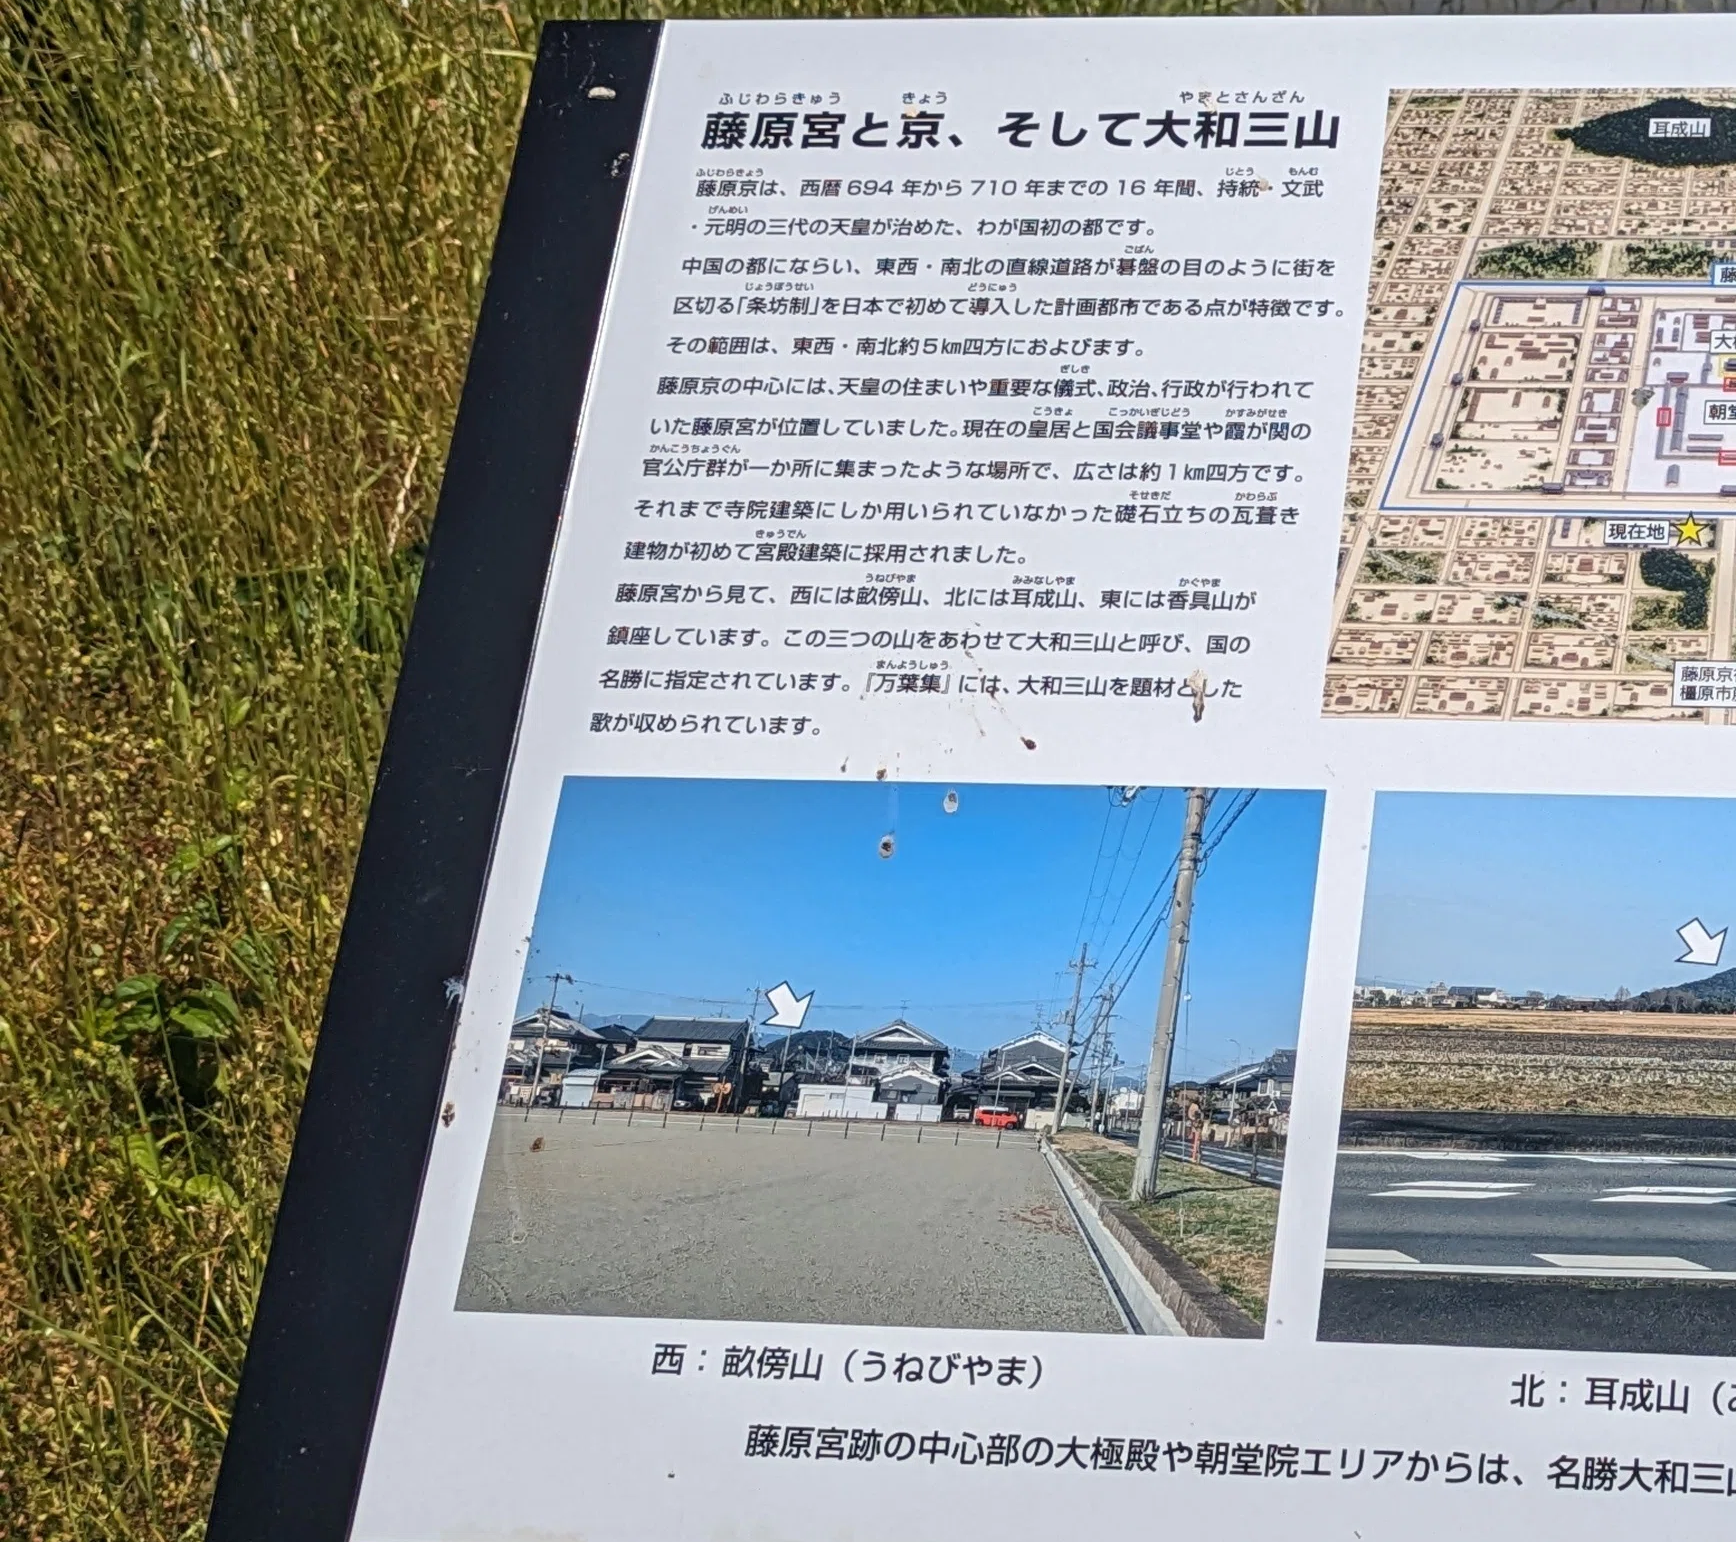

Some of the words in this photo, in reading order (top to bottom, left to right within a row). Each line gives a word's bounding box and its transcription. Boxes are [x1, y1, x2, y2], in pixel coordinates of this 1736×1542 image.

[719, 92, 840, 105] ふじわらきゅう
[903, 92, 947, 104] きょう
[701, 110, 1339, 149] 藤原宮と京、そして大和三山
[1652, 119, 1708, 138] 耳成山
[696, 168, 763, 177] ふじわらきょう
[1226, 167, 1254, 176] じとう
[1289, 167, 1318, 175] もんむ
[709, 206, 748, 214] げんめい
[1125, 245, 1154, 254] ごばん
[746, 282, 813, 291] じょうぼうせい
[968, 283, 1016, 292] どうにゅう
[1061, 365, 1090, 373] ぎしき
[1033, 407, 1072, 416] こうきょ
[1109, 408, 1190, 417] こっかいぎじどう
[1226, 409, 1287, 418] かすみがせき
[650, 444, 740, 453] かんこうちょうぐん
[1129, 491, 1171, 500] そせきだ
[1235, 492, 1277, 501] かわらぶ
[756, 529, 806, 538] きゅうでん
[1608, 523, 1664, 540] 現在地
[624, 541, 1025, 564] 建物が初めて宮殿建築に採用されました。
[866, 573, 915, 583] うねびやま
[1013, 576, 1075, 585] みみなしやま
[1179, 578, 1220, 587] かぐやま
[876, 660, 948, 670] まんようしゅう
[590, 713, 819, 735] 歌が収められています。
[652, 1344, 1042, 1388] 西：畝傍山（うねびやま）
